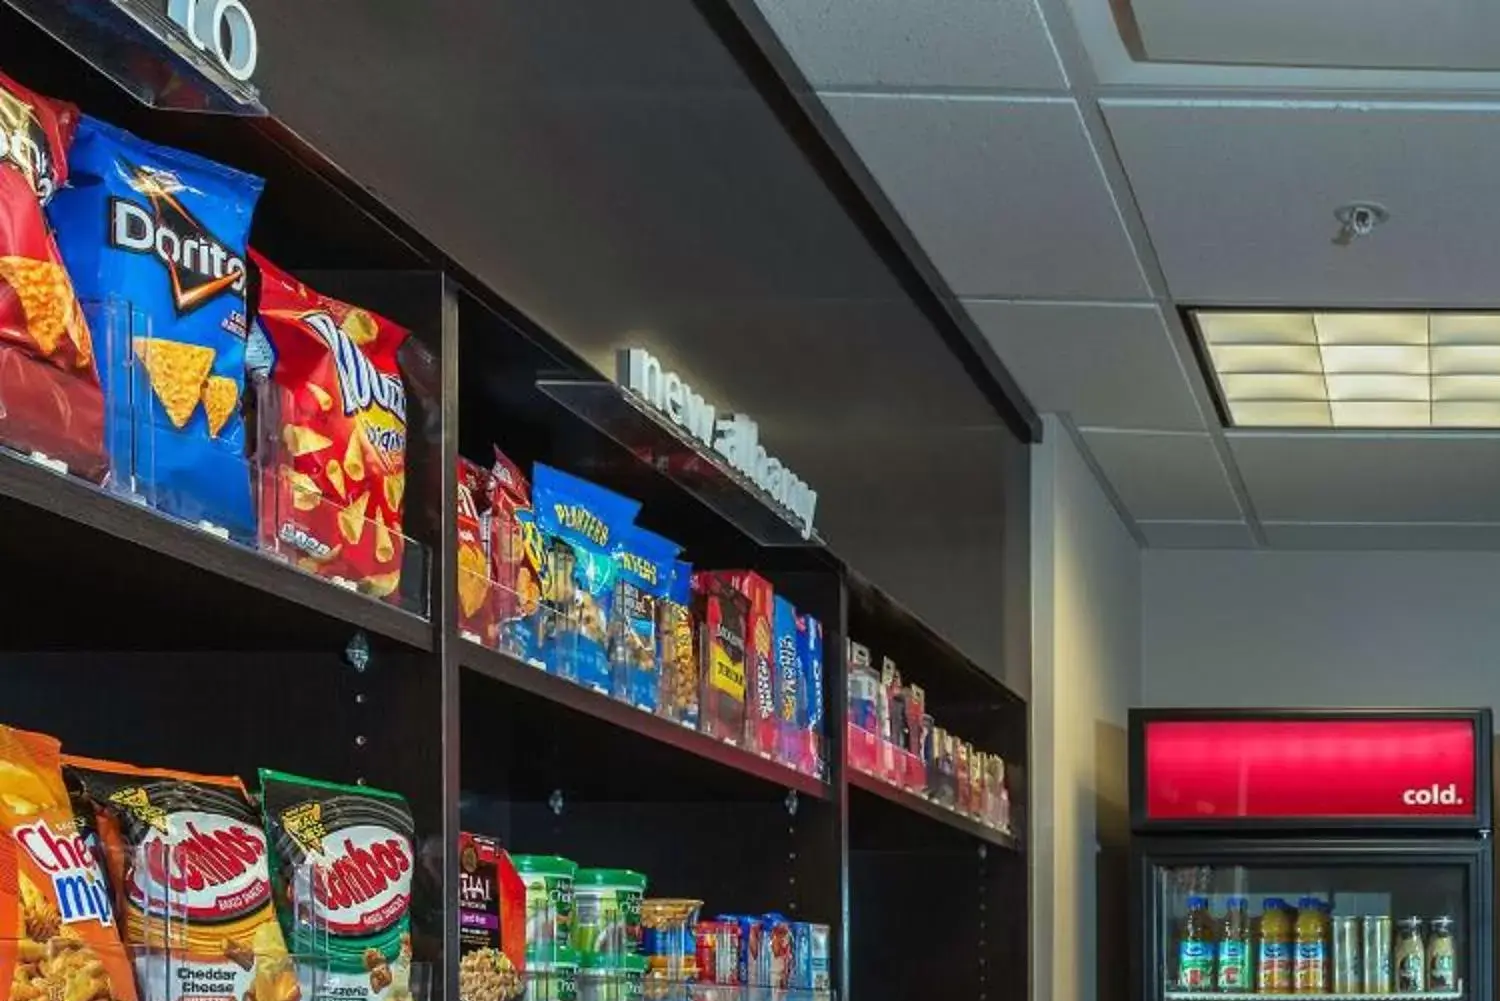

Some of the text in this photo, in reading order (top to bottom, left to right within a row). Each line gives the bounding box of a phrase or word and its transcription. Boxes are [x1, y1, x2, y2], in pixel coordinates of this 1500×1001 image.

[115, 200, 246, 292] Dorito
[1403, 784, 1463, 805] cold.
[177, 967, 237, 982] Cheddar
[182, 982, 234, 994] Cheese
